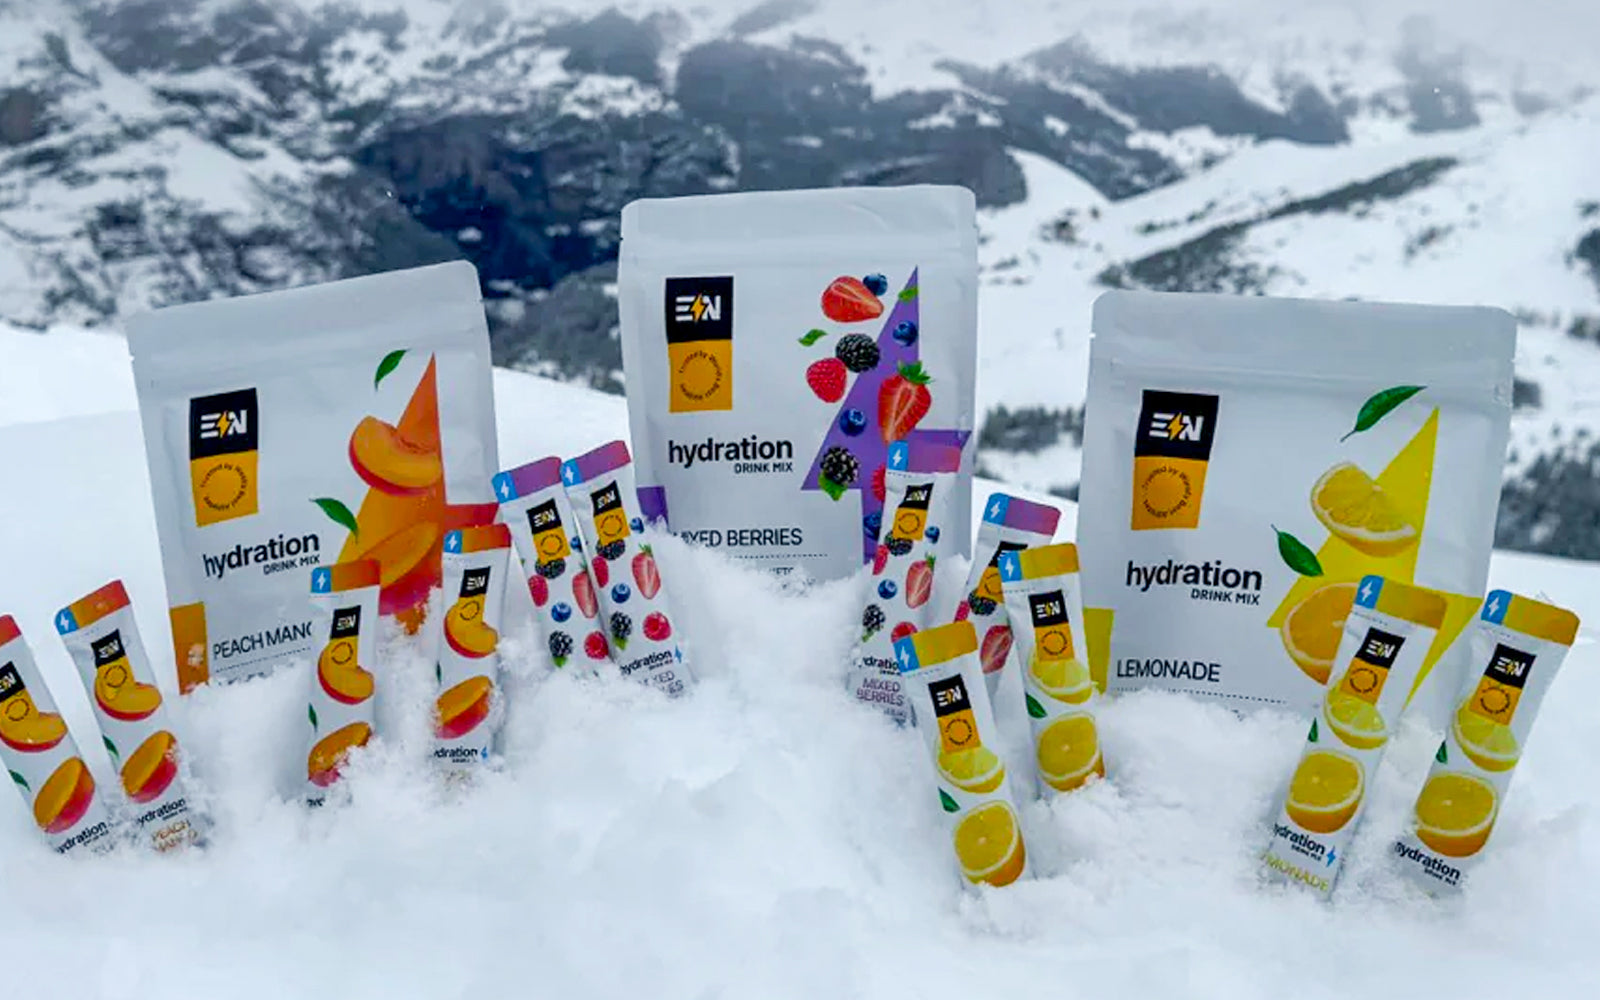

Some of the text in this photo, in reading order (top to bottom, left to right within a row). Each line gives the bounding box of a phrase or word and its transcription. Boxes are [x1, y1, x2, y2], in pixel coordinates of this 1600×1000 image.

[668, 435, 793, 469] hydration
[734, 462, 793, 474] DRINK MIX
[727, 528, 803, 546] BERRIES
[203, 534, 320, 579] hydration
[263, 554, 320, 575] DRINK MIX
[1126, 560, 1262, 591] hydration
[1190, 588, 1260, 606] DRINK MIX
[213, 632, 264, 660] PEACH
[1117, 659, 1221, 682] LEMONADE
